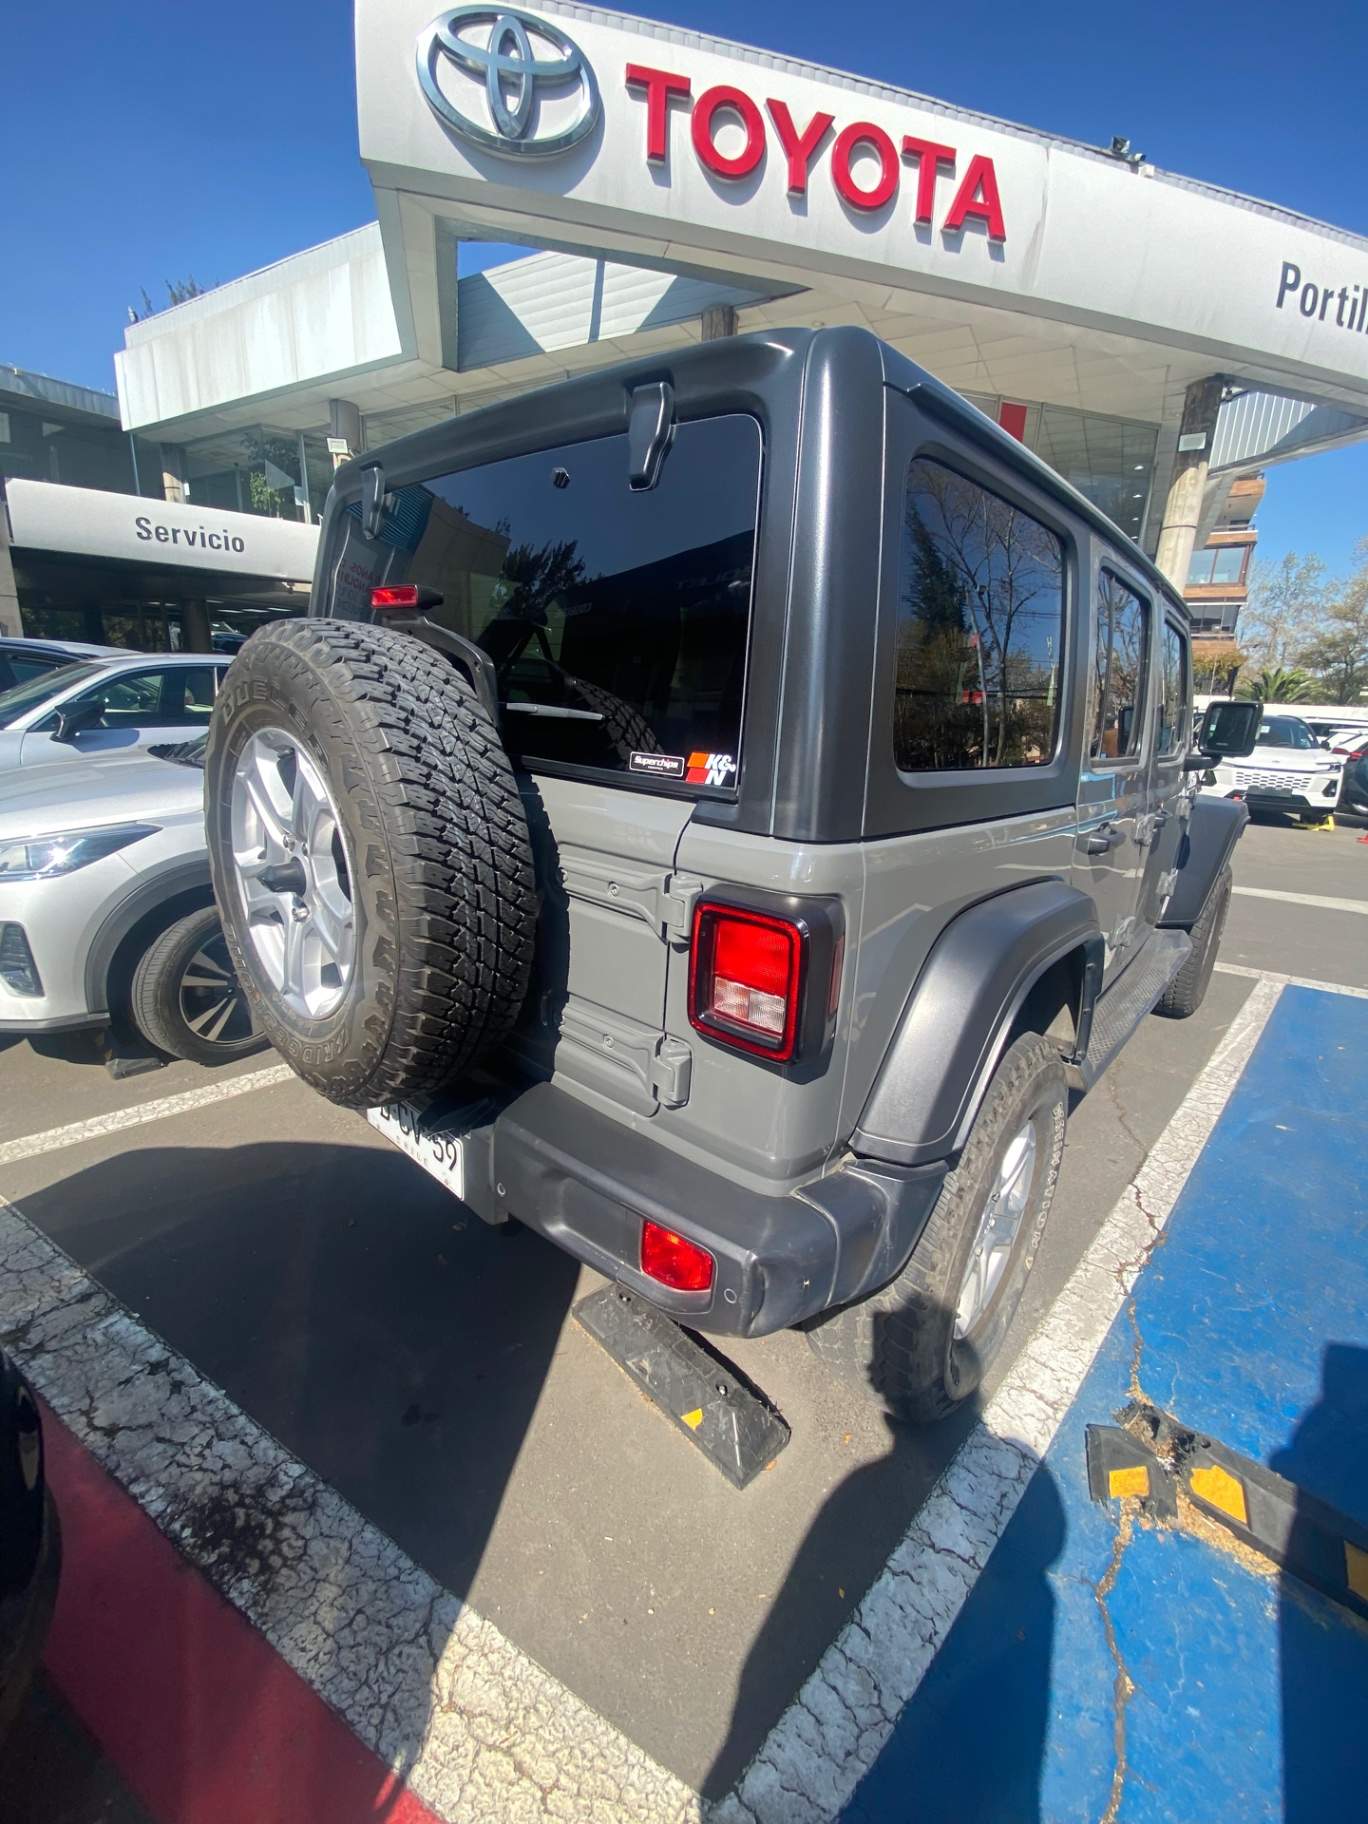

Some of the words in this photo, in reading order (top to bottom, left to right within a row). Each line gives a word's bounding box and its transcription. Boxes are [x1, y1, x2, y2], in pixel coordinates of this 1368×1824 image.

[625, 63, 1006, 243] TOYOTA
[1276, 260, 1368, 335] Portil
[135, 516, 244, 552] Servicio
[634, 755, 679, 769] Superchips
